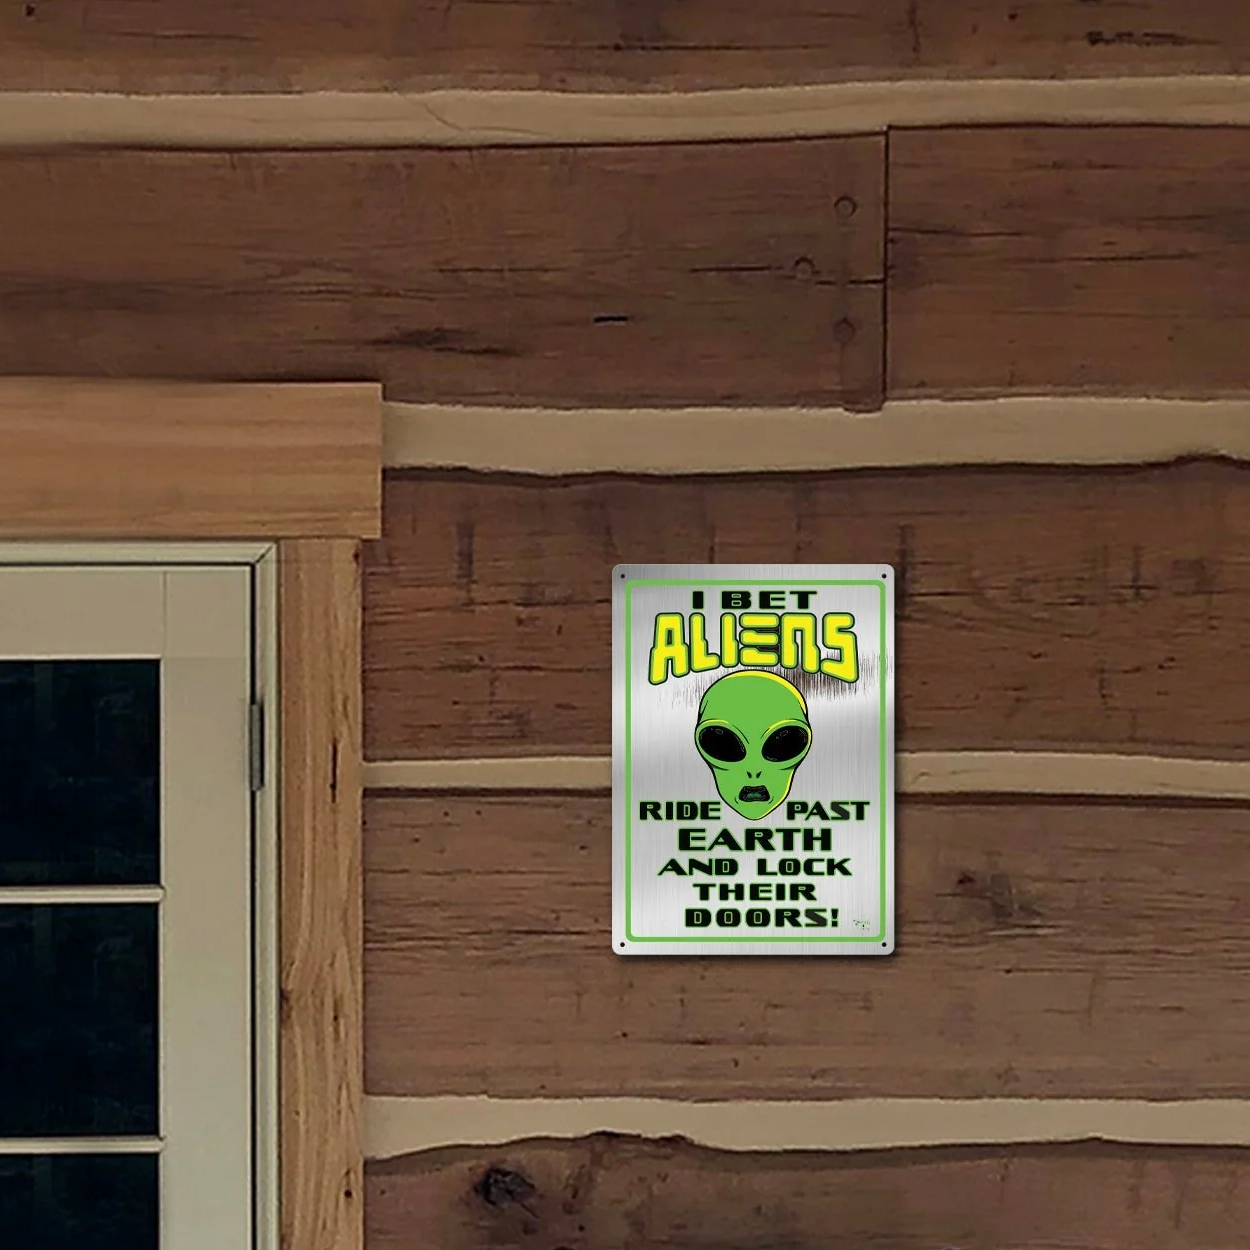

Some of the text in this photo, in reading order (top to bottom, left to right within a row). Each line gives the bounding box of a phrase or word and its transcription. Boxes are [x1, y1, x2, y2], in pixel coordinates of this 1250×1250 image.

[692, 591, 817, 610] I BET
[648, 612, 859, 685] ALIENS
[639, 801, 870, 821] RIDE PAST
[678, 828, 832, 851] EARTH
[657, 858, 852, 876] AND LOCK
[693, 883, 817, 901] THEIR
[685, 908, 839, 927] DOORS!
